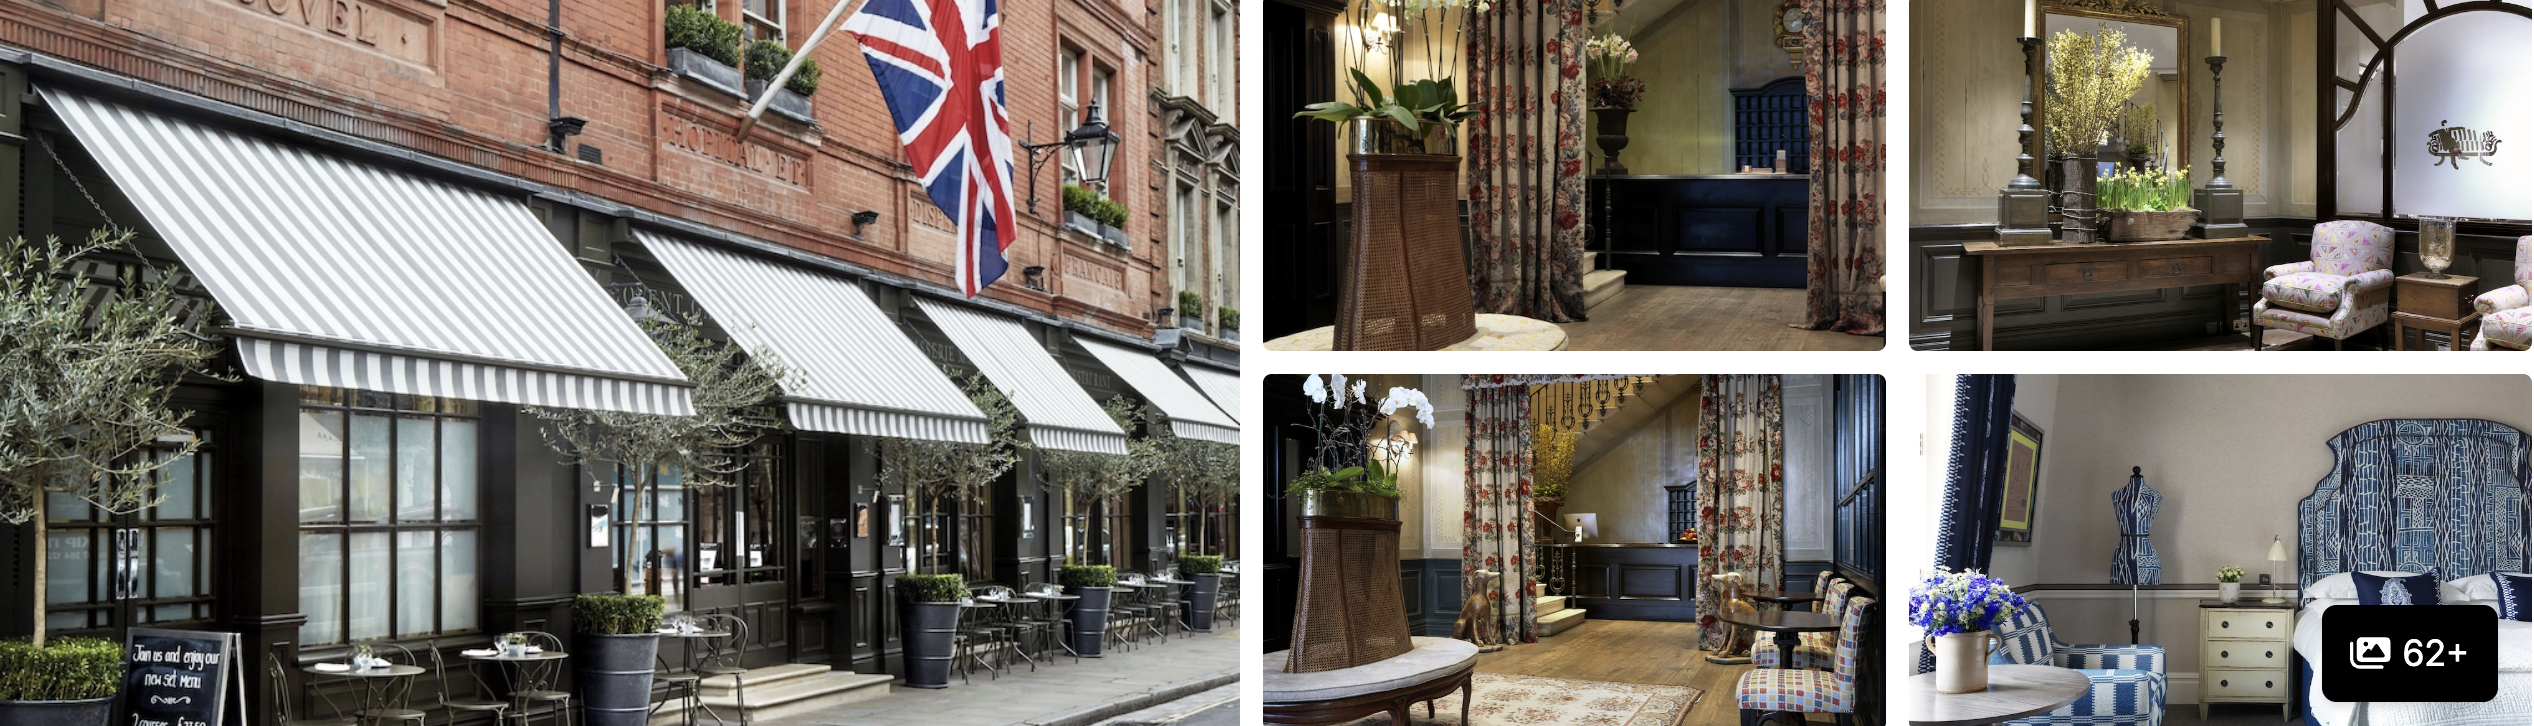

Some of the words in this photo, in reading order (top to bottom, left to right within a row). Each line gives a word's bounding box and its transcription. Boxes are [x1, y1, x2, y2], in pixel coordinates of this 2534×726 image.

[239, 0, 377, 47] VEL
[912, 200, 957, 235] DISPE
[615, 285, 684, 315] OENT
[153, 651, 163, 662] us
[165, 645, 181, 663] and
[183, 650, 204, 671] enjoy
[205, 652, 220, 665] our
[144, 673, 162, 686] new
[163, 669, 177, 688] set
